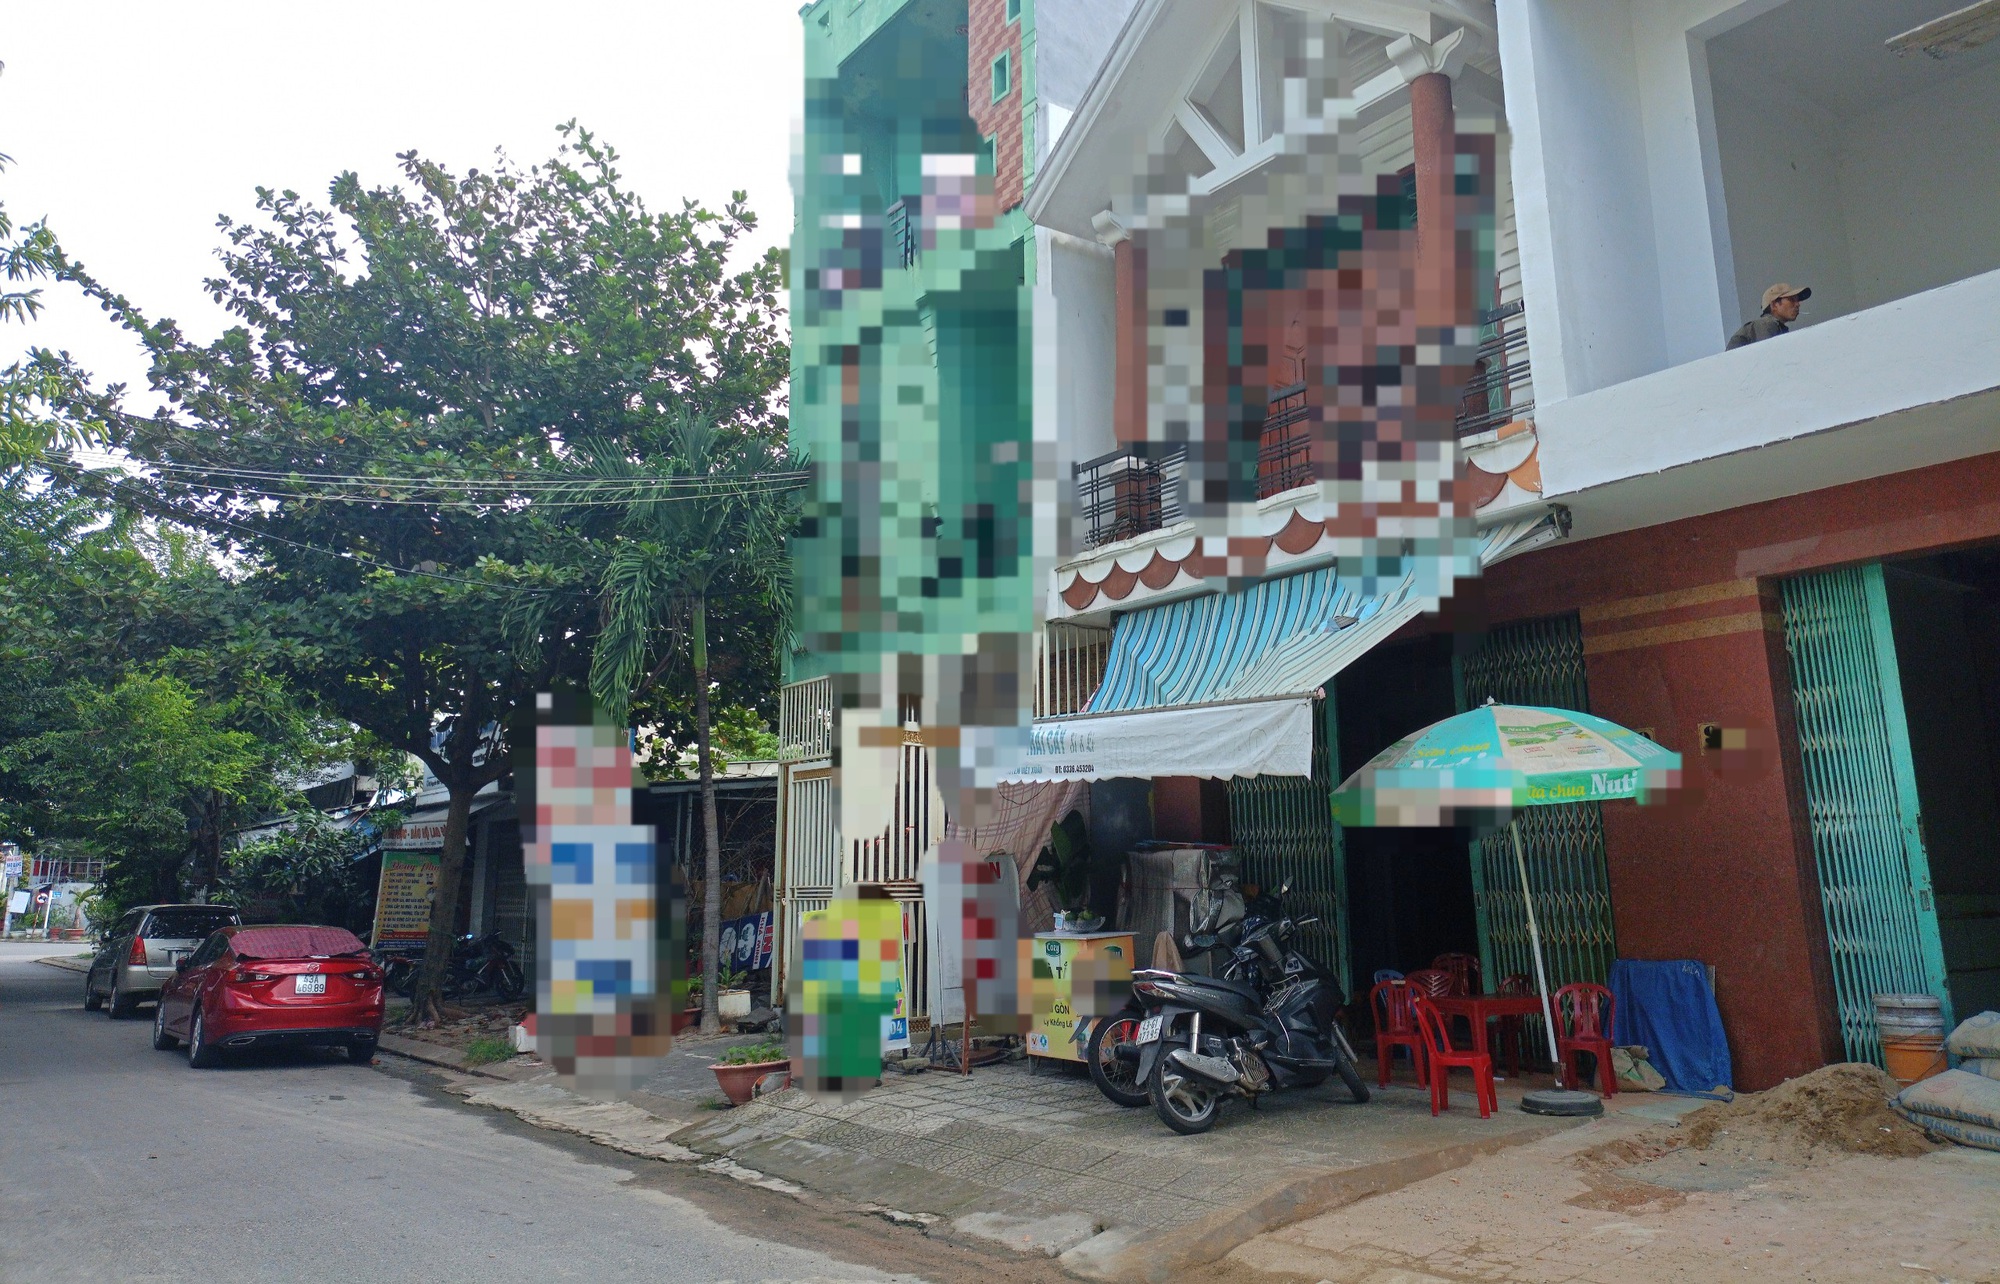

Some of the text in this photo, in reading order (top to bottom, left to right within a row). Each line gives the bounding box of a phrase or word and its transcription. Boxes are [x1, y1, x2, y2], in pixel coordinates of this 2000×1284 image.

[1549, 784, 1586, 798] chua
[1590, 770, 1638, 795] Nuti
[296, 983, 325, 993] 469.89
